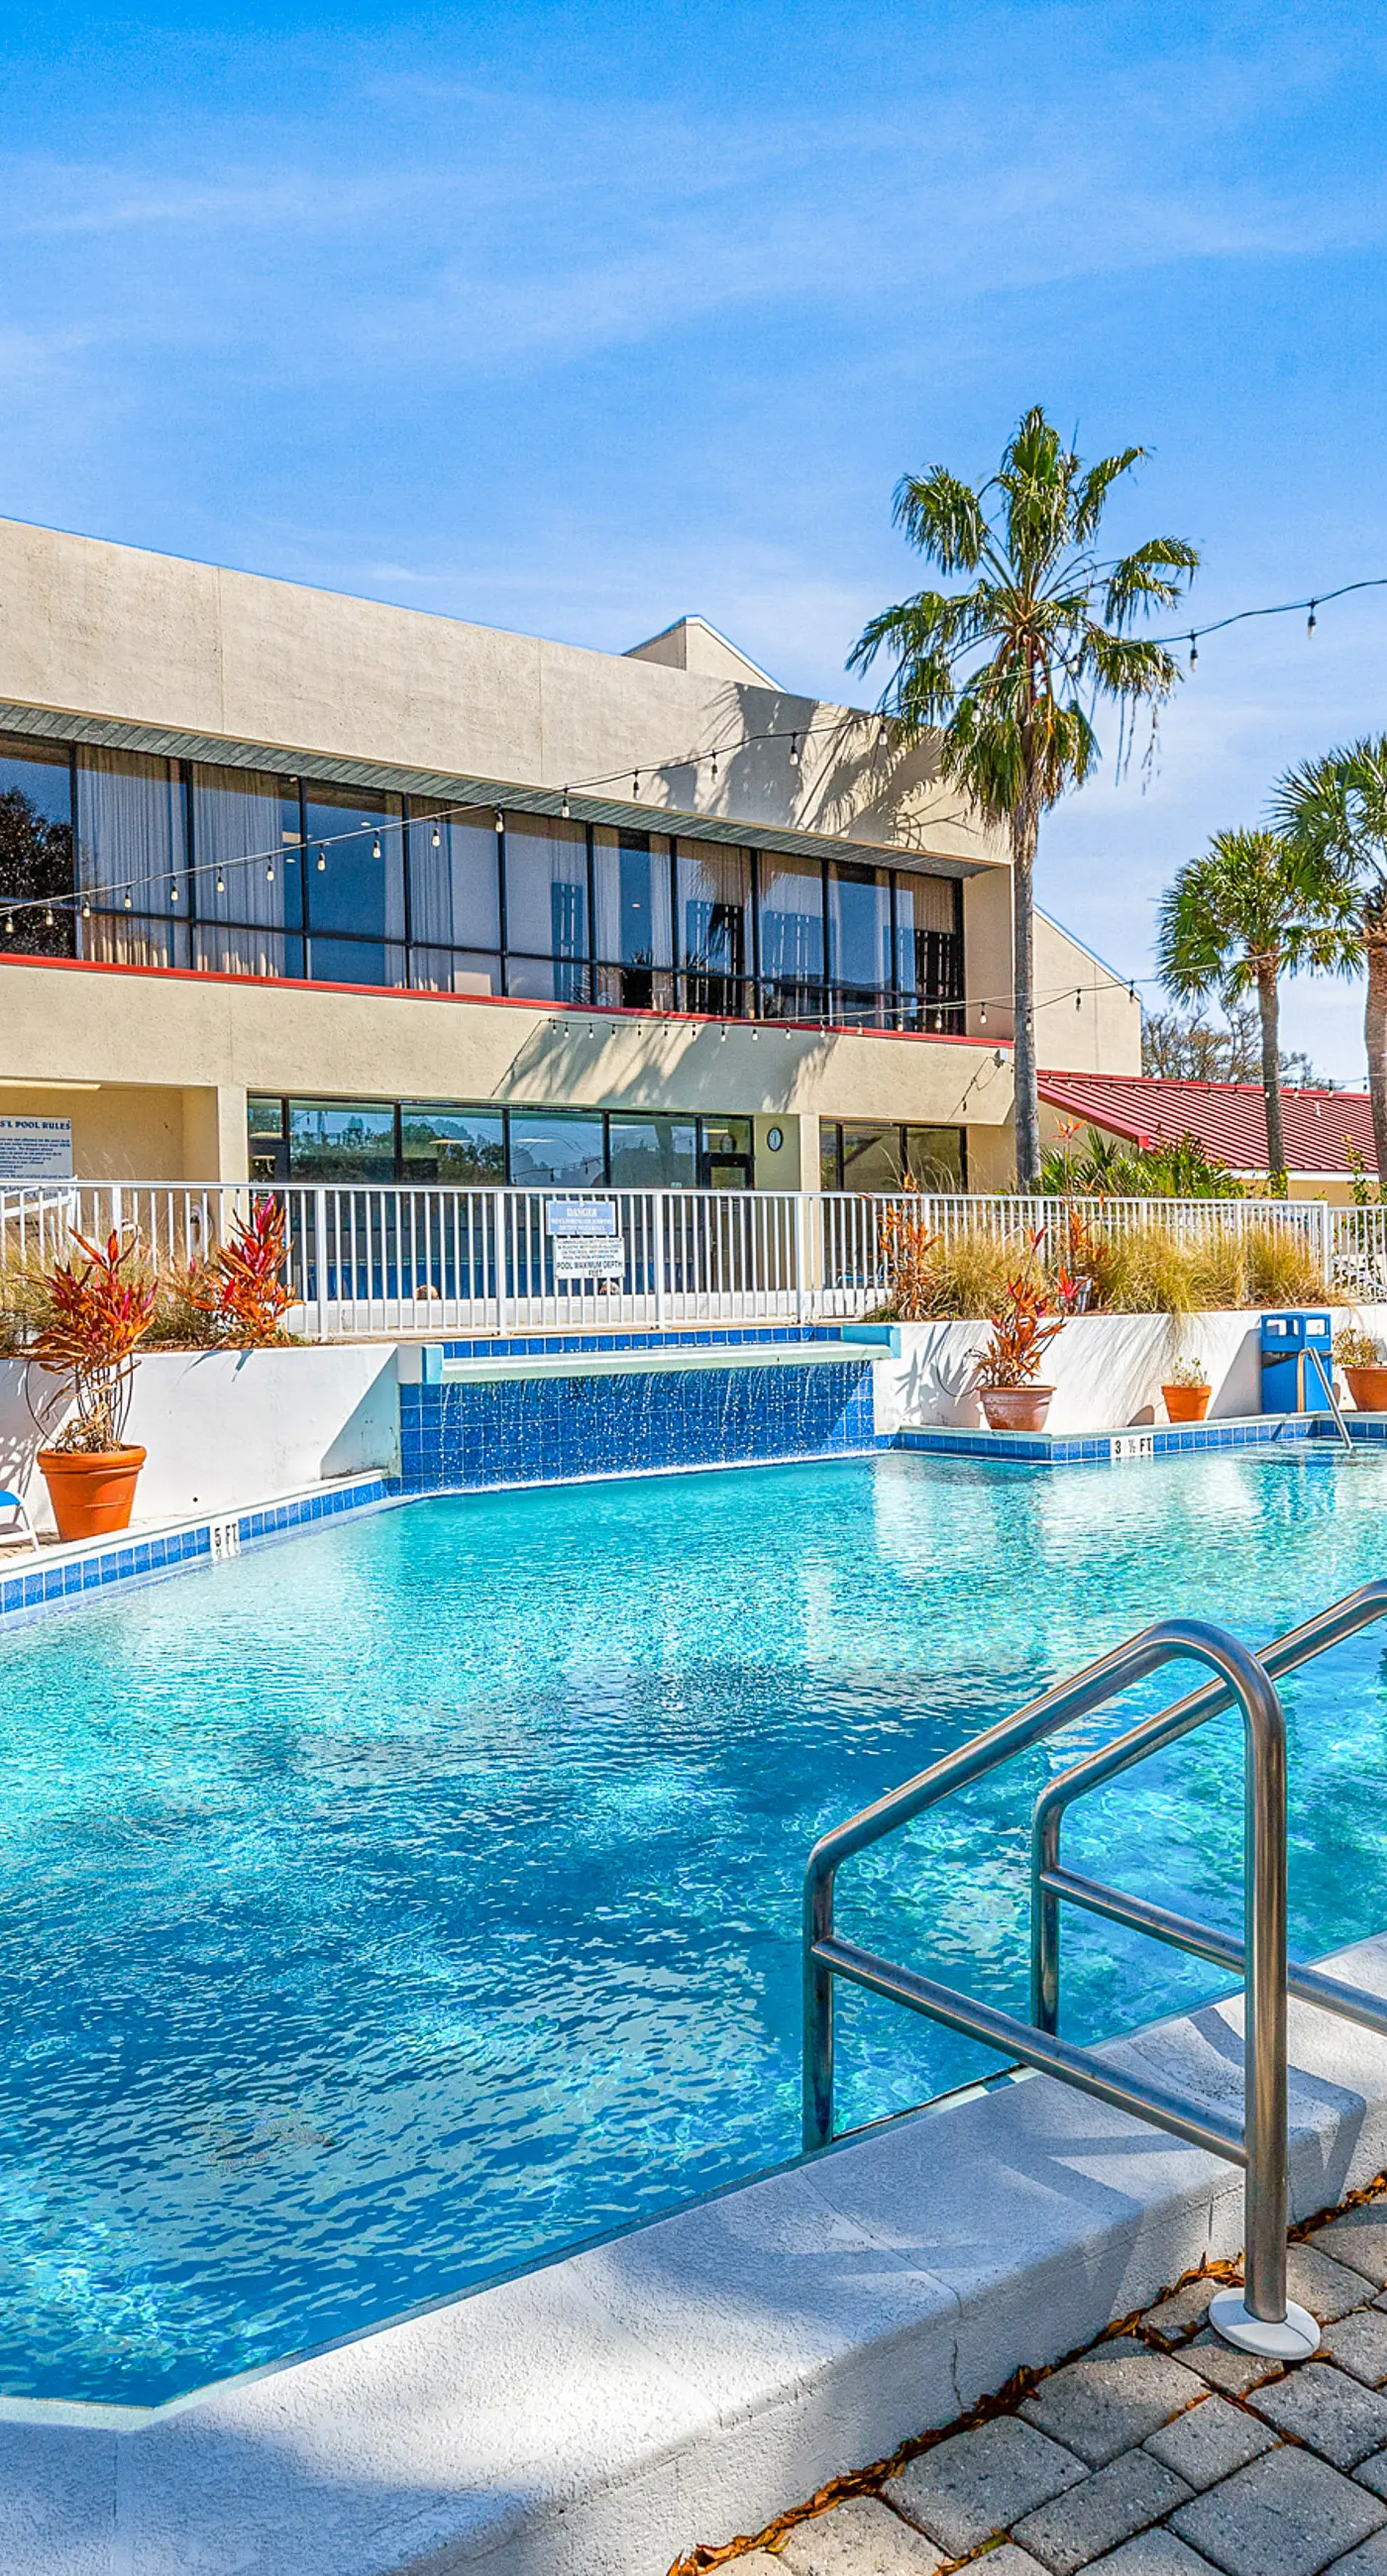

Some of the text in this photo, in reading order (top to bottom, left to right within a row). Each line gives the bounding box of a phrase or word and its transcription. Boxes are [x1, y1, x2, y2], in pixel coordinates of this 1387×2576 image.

[567, 1207, 596, 1217] DANGER
[575, 1261, 602, 1270] MAXIMUM
[1115, 1440, 1121, 1454] 3
[1139, 1437, 1152, 1452] FT
[215, 1523, 238, 1547] 5 FT
